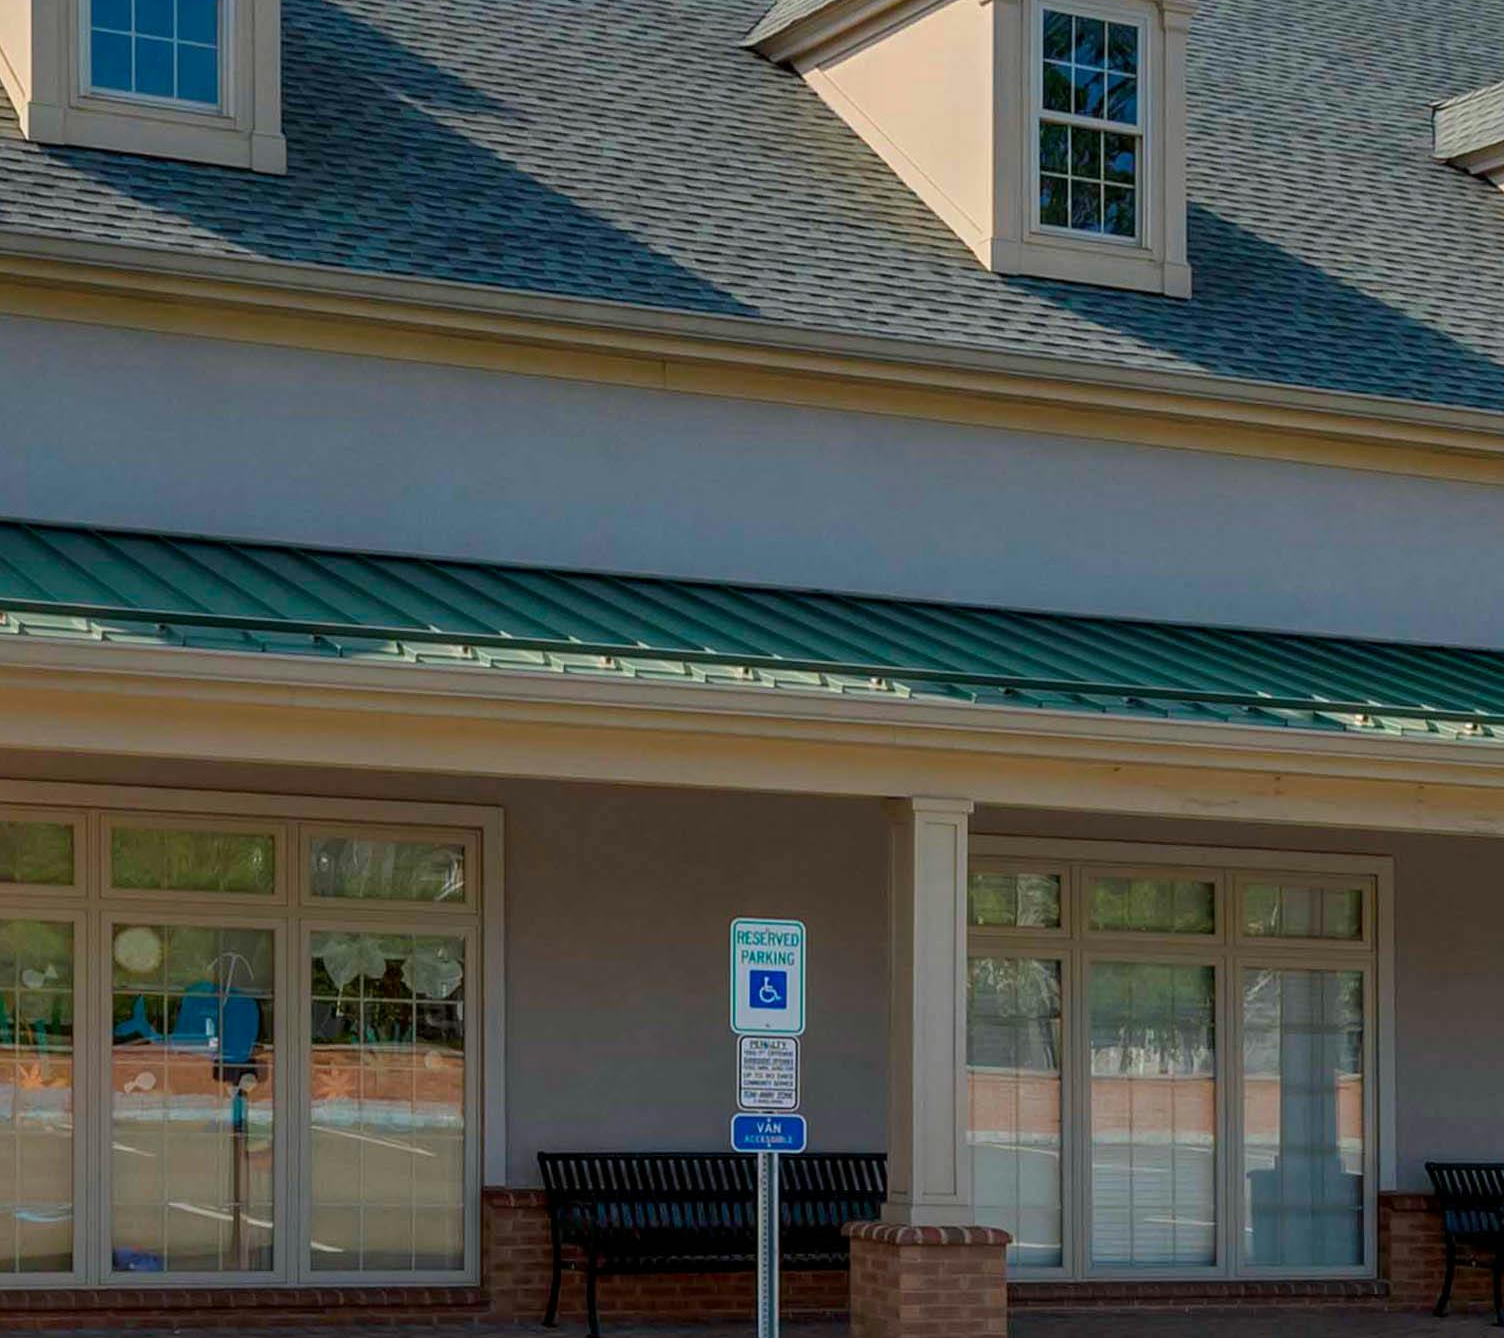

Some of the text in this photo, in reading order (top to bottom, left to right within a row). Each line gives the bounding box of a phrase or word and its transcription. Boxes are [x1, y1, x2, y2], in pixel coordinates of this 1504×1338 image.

[737, 930, 800, 948] RESERVED
[741, 949, 796, 966] PARKING
[757, 1121, 782, 1134] VAN
